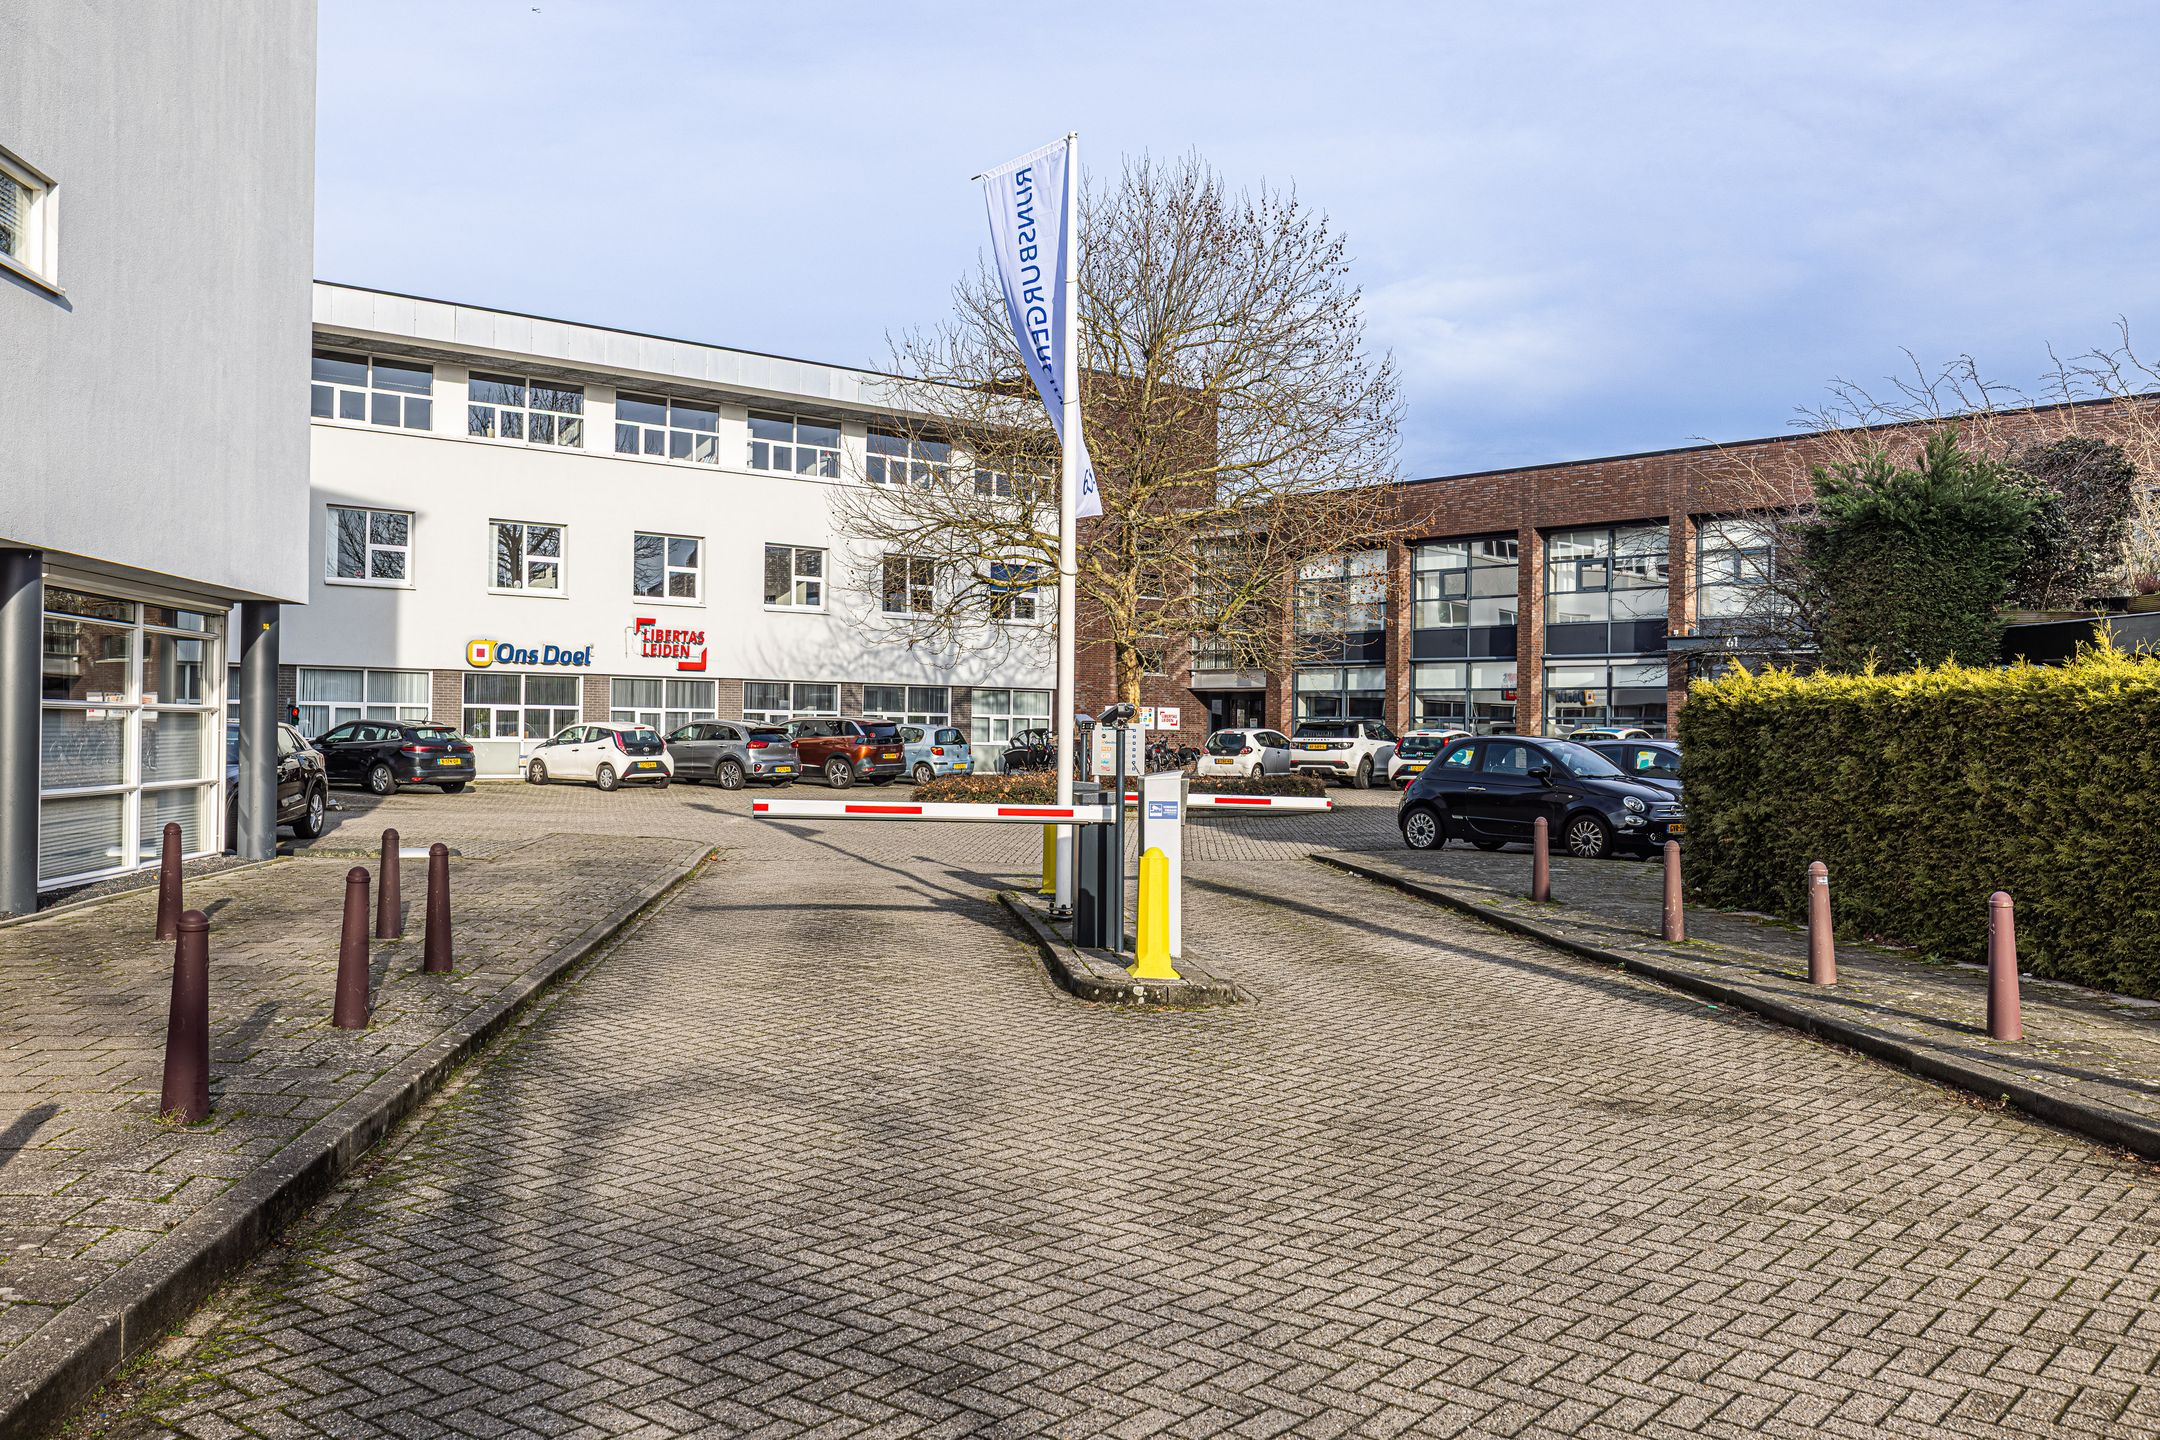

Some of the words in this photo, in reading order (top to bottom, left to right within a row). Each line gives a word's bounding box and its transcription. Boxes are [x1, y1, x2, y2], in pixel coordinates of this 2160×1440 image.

[643, 628, 705, 644] LIBERTAS
[1726, 636, 1739, 648] 61
[496, 642, 539, 665] Ons
[541, 644, 592, 666] Doel
[642, 643, 690, 658] LEIDEN
